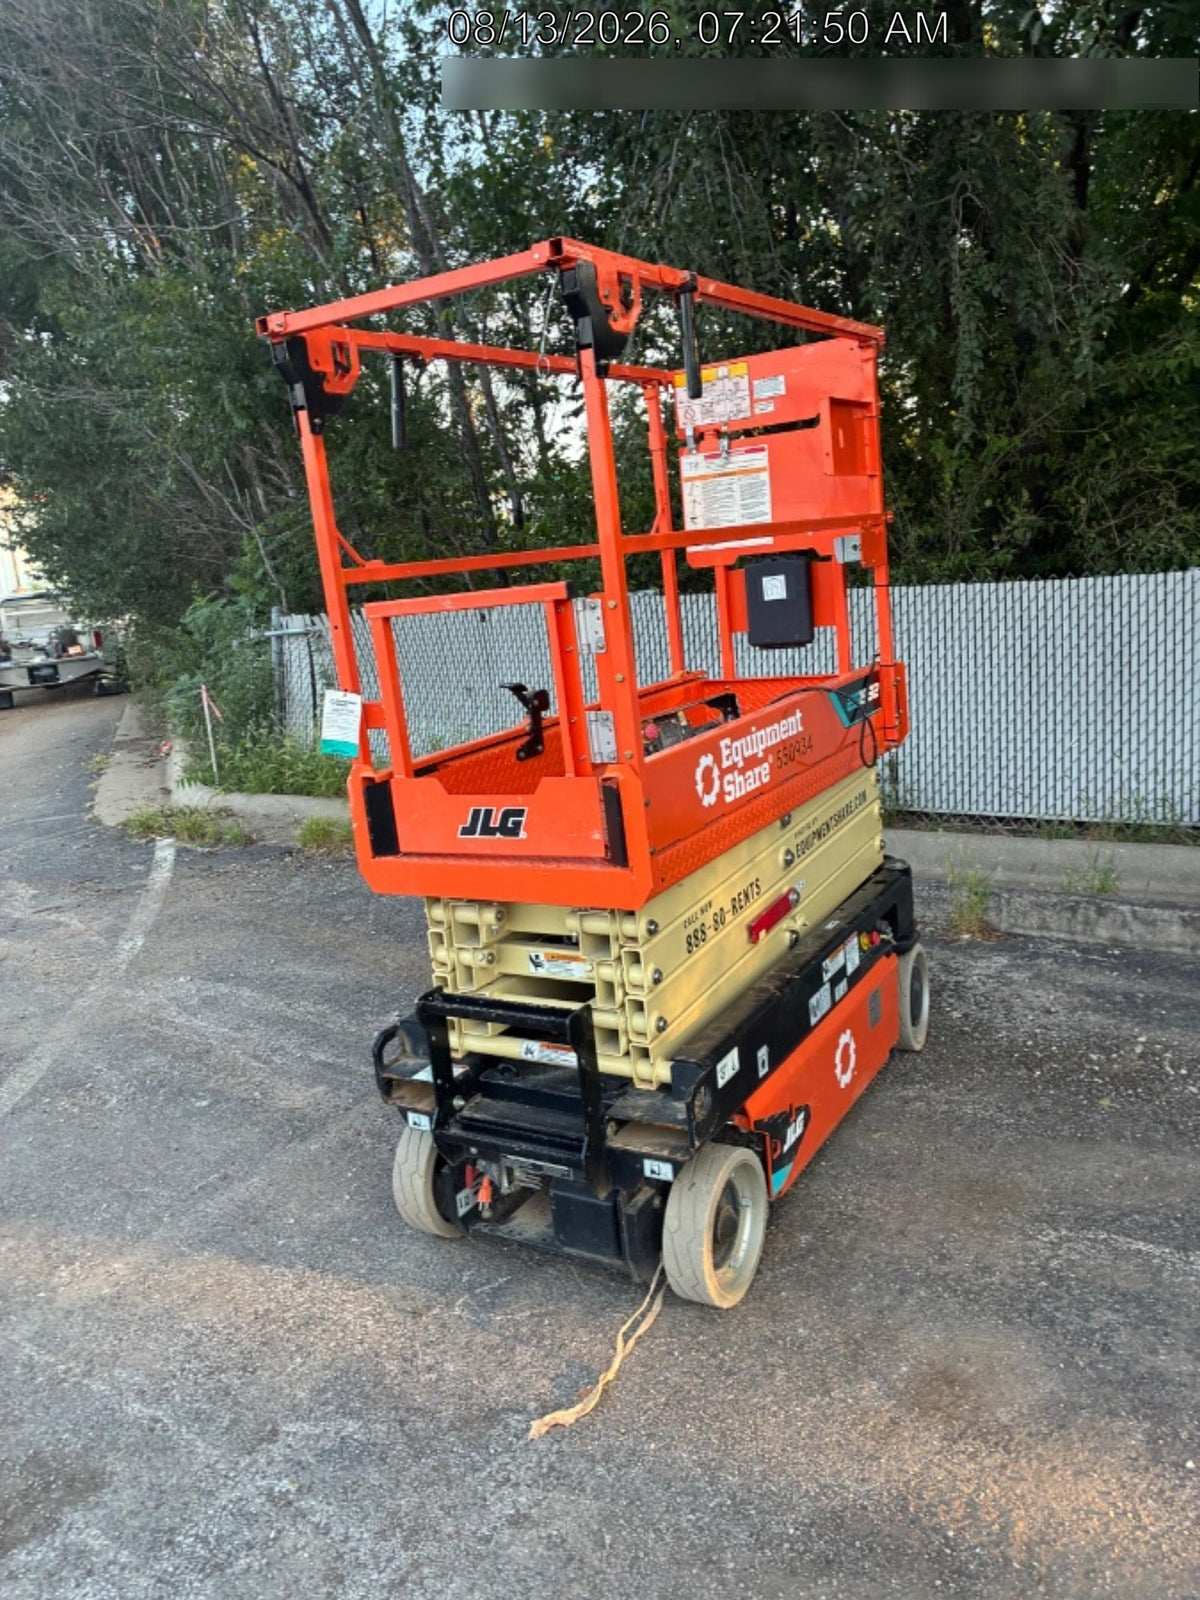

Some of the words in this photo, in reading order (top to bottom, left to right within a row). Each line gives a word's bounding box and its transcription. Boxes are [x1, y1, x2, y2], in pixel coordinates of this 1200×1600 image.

[719, 708, 804, 768] Equipment
[458, 807, 527, 839] JLG
[795, 789, 867, 858] EQUIPMENTSHARE.COM
[685, 877, 762, 954] 888-80-RENTS
